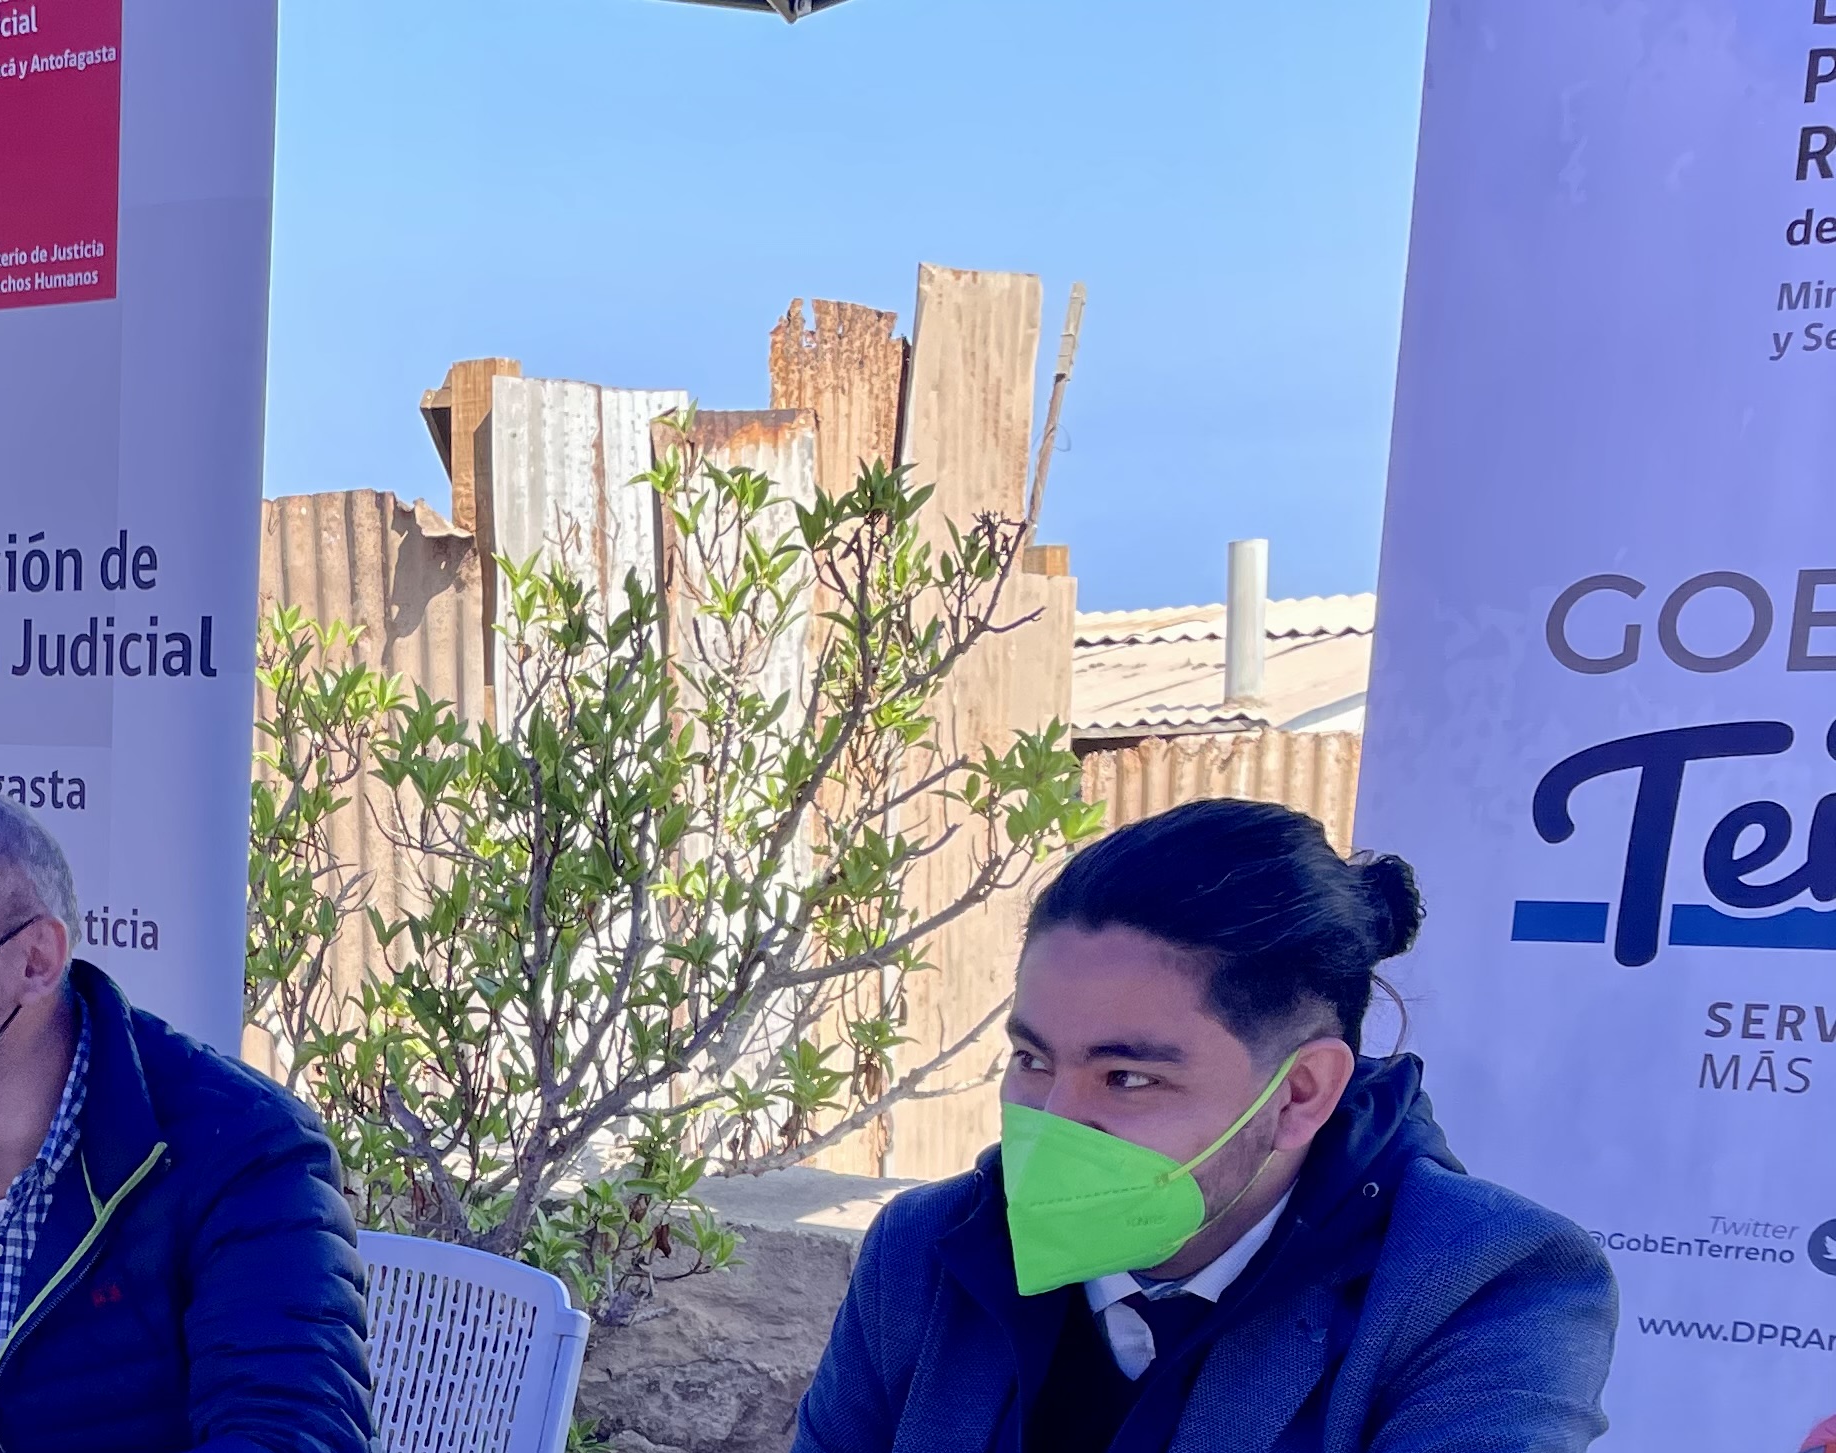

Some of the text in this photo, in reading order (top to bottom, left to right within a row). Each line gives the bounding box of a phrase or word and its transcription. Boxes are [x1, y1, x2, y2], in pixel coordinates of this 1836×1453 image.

[19, 60, 27, 80] y
[30, 46, 117, 71] Antofagasta
[1786, 208, 1836, 246] de
[31, 246, 48, 264] de
[51, 239, 104, 262] Justicia
[34, 270, 98, 290] Humanos
[1769, 332, 1794, 361] y
[100, 529, 158, 591] de
[11, 615, 218, 677] Judicial
[1708, 1216, 1800, 1239] Twitter
